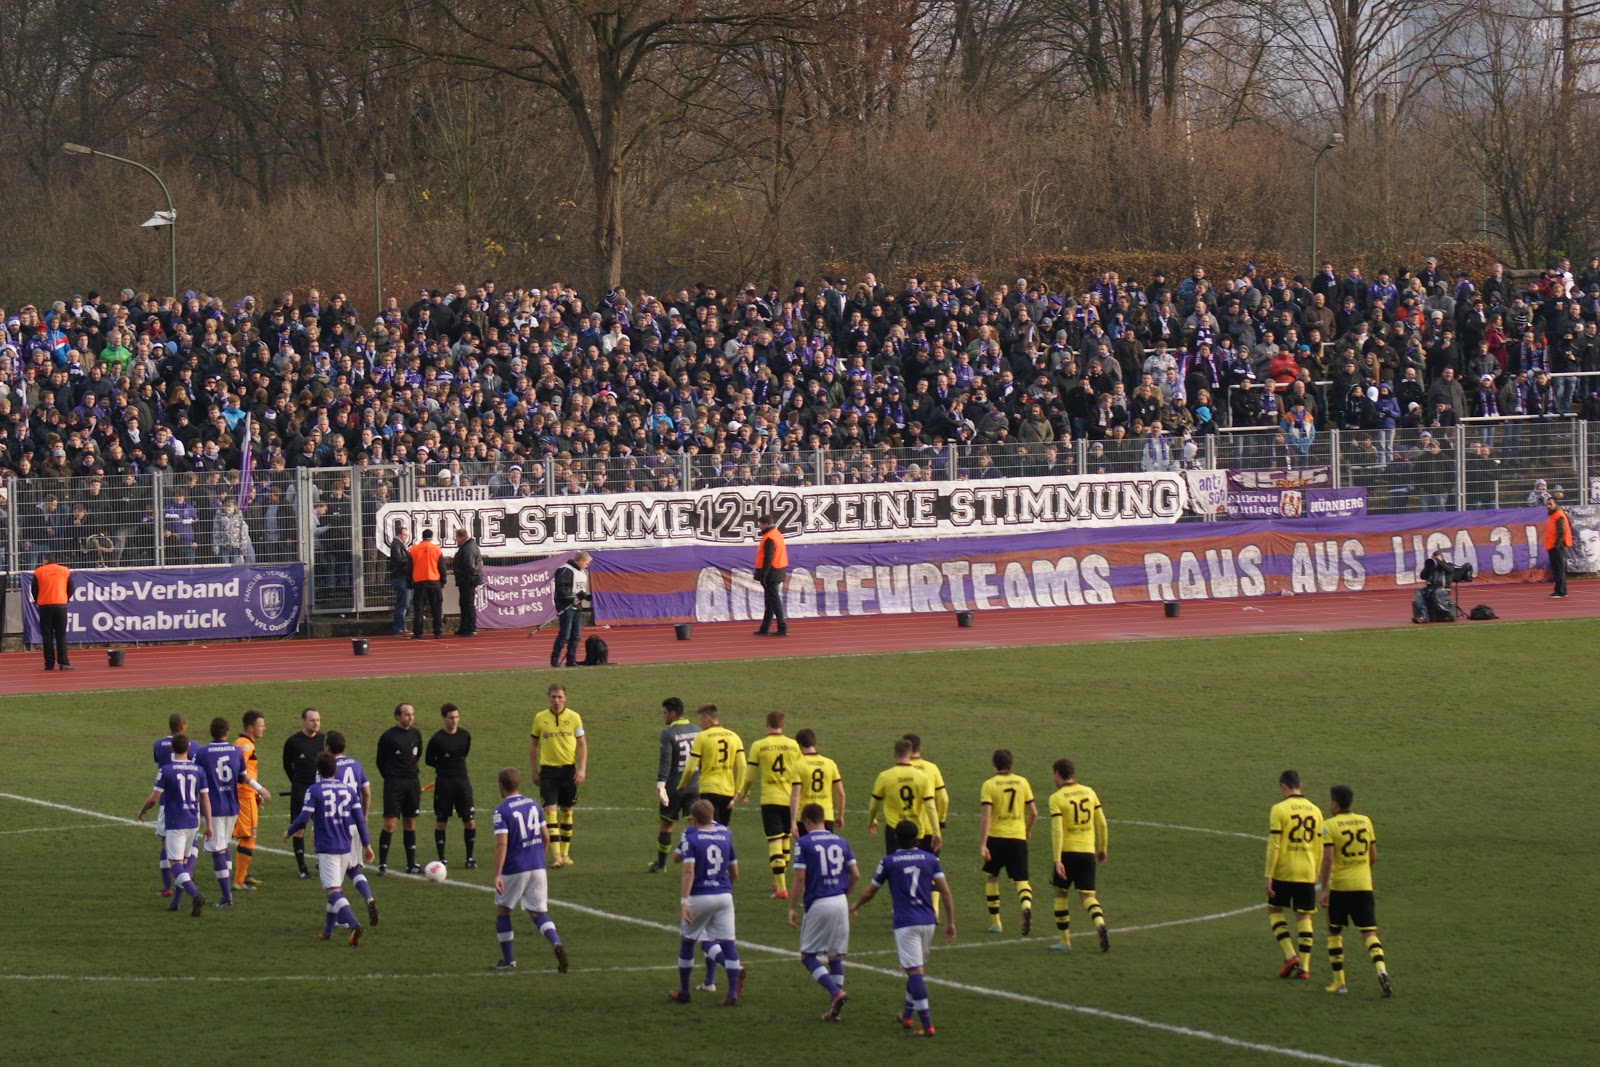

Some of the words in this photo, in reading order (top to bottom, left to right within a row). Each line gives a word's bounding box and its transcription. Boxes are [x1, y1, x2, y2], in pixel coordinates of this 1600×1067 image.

[383, 508, 506, 548] OHNE
[519, 501, 696, 545] STIMME
[803, 488, 939, 534] KEINE
[949, 479, 1182, 526] STIMMUNG
[1310, 497, 1364, 513] NÜRNBERG
[1143, 545, 1265, 601] RAUS
[1291, 539, 1366, 594] AUS
[1392, 529, 1478, 586] LIGA
[29, 578, 240, 603] club-Verband
[65, 612, 87, 633] fL
[92, 609, 227, 632] Osnabrück
[717, 739, 729, 763] 3
[771, 753, 786, 776] 4
[215, 755, 233, 782] 6
[342, 766, 358, 794] 4
[811, 768, 824, 793] 8
[176, 773, 197, 801] 11
[900, 785, 915, 811] 9
[1003, 787, 1017, 812] 7
[322, 789, 352, 817] 32
[1069, 798, 1091, 825] 15
[512, 805, 541, 839] 14
[1289, 814, 1315, 843] 28
[1341, 828, 1367, 857] 25
[706, 844, 724, 876] 9
[814, 844, 845, 876] 19
[903, 865, 921, 897] 7
